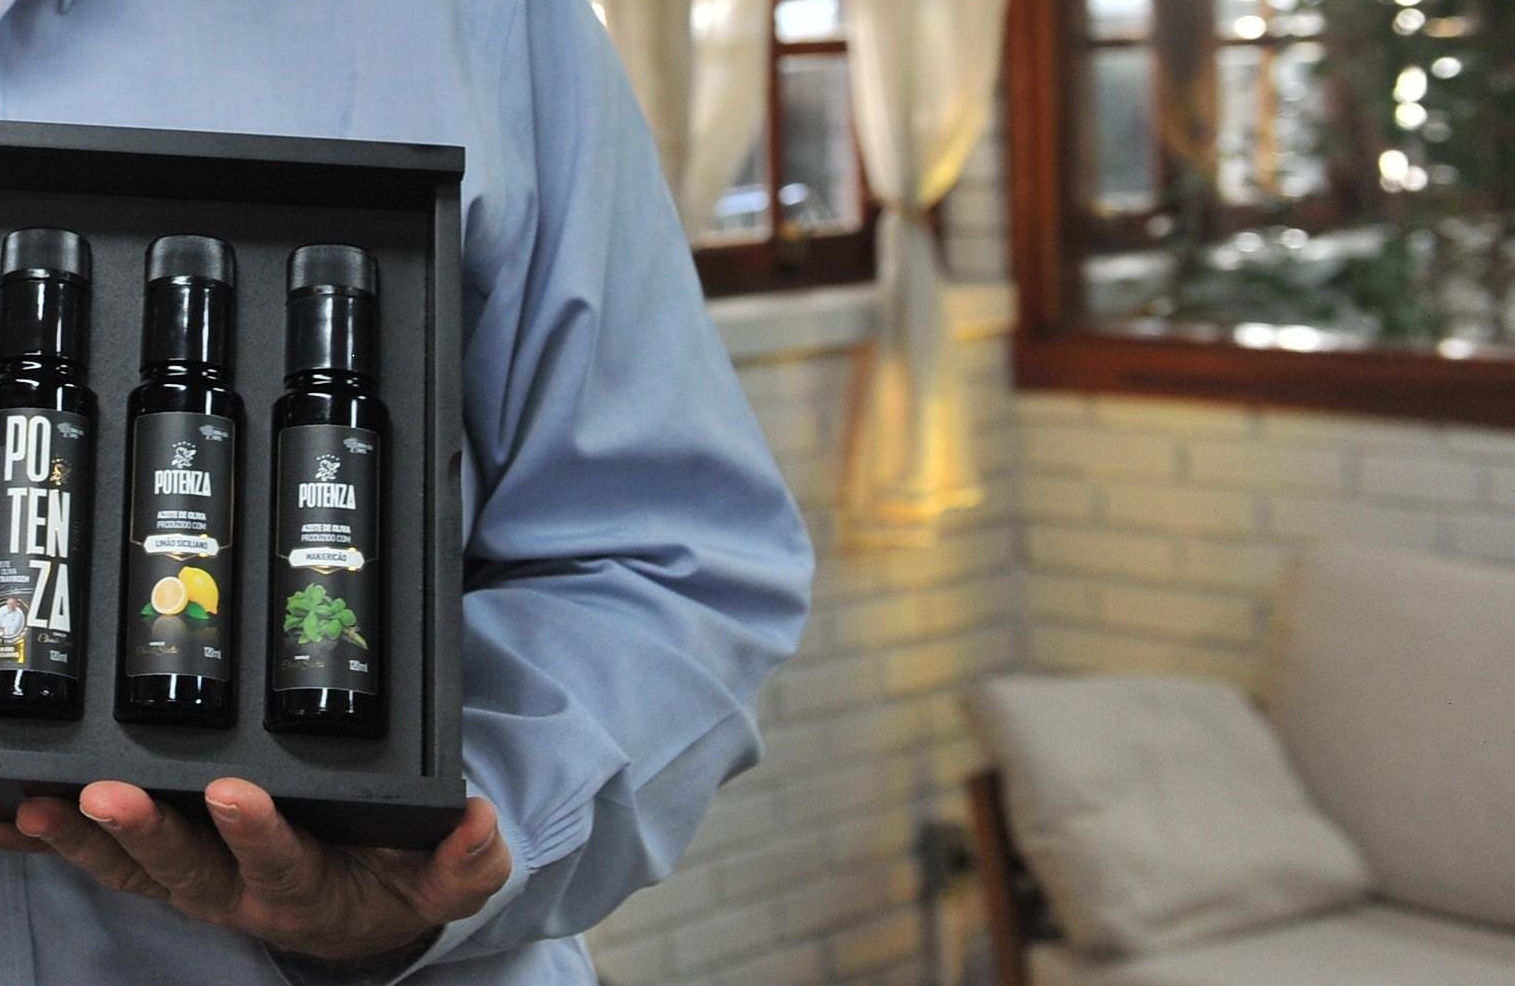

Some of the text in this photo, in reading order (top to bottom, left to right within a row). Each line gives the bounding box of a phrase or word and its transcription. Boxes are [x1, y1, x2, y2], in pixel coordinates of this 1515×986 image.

[4, 415, 51, 482] PO
[154, 469, 212, 497] POTENZA
[298, 482, 356, 510] POTENZA
[7, 487, 70, 558] TEN
[26, 560, 71, 632] ZA
